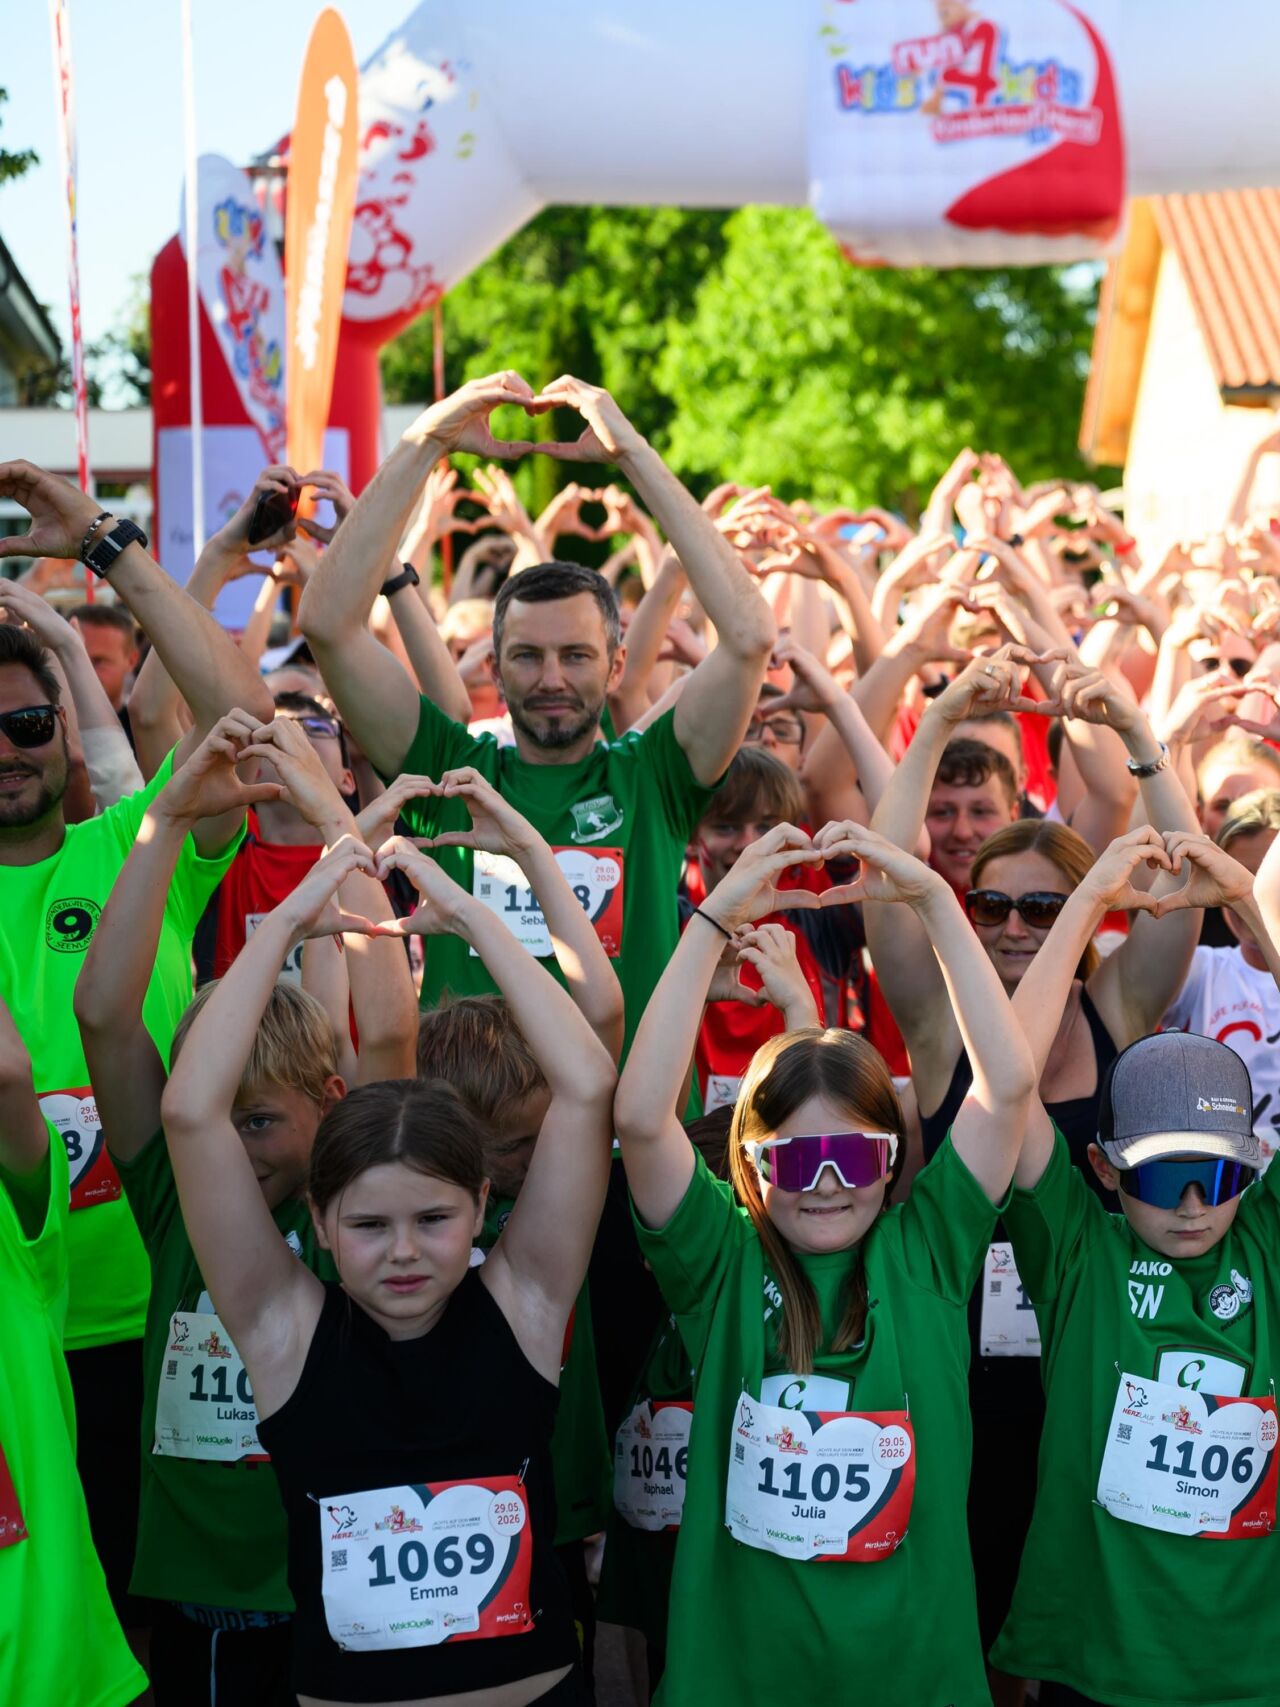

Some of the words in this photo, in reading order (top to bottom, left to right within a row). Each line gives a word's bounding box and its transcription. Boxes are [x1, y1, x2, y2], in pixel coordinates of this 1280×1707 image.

[896, 36, 962, 72] run
[943, 20, 998, 104] 4
[596, 874, 615, 882] 2026
[504, 884, 591, 912] 118
[53, 907, 93, 942] 9
[1130, 1261, 1172, 1276] JAKO
[217, 1407, 255, 1421] Lukas
[196, 1435, 233, 1446] WaldQuelle
[879, 1437, 906, 1447] 29.05.
[1261, 1432, 1276, 1442] 2026
[880, 1448, 905, 1458] 2026
[1145, 1434, 1255, 1484] 1106
[630, 1444, 688, 1480] 1046
[758, 1457, 870, 1502] 1105
[643, 1482, 675, 1496] Raphael
[1175, 1481, 1219, 1499] Simon
[497, 1514, 521, 1525] 2026
[791, 1505, 826, 1520] Julia
[1152, 1504, 1192, 1520] WaldQuelle
[331, 1528, 369, 1541] HERZLAUF
[766, 1528, 805, 1544] WaldQuelle
[368, 1533, 495, 1587] 1069
[410, 1585, 458, 1601] Emma
[389, 1618, 434, 1633] WaldQuelle
